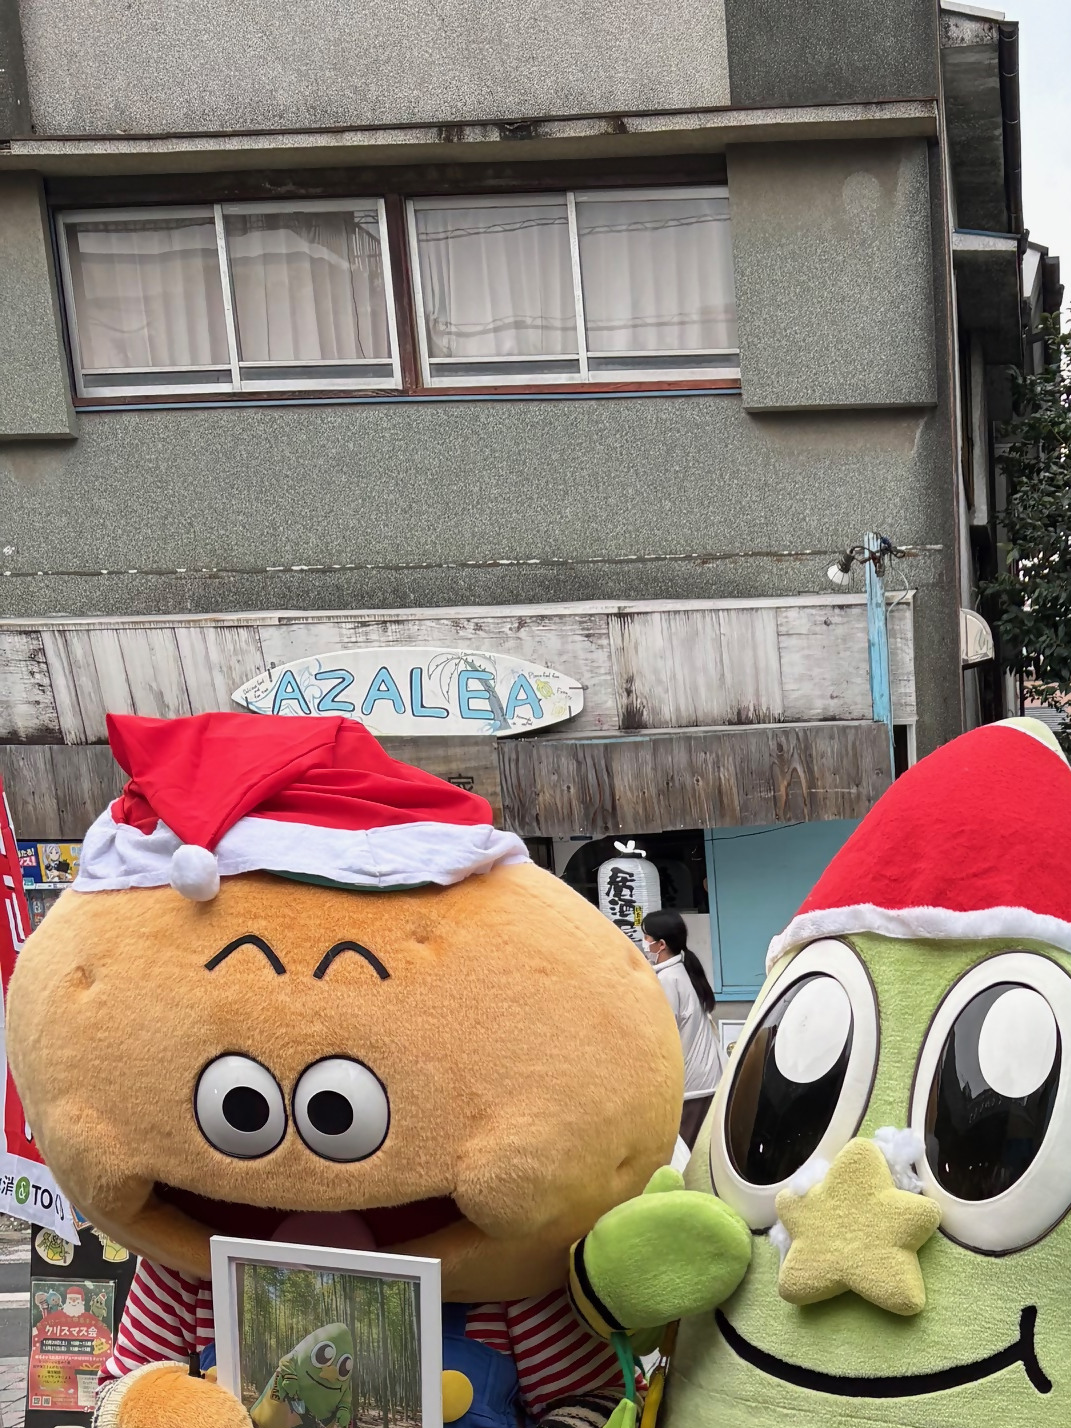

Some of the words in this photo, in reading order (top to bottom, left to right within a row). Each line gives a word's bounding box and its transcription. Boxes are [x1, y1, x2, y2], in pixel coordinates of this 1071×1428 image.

[272, 666, 544, 719] AZALEA
[0, 1175, 15, 1196] 消
[45, 1326, 97, 1337] クリスマス会
